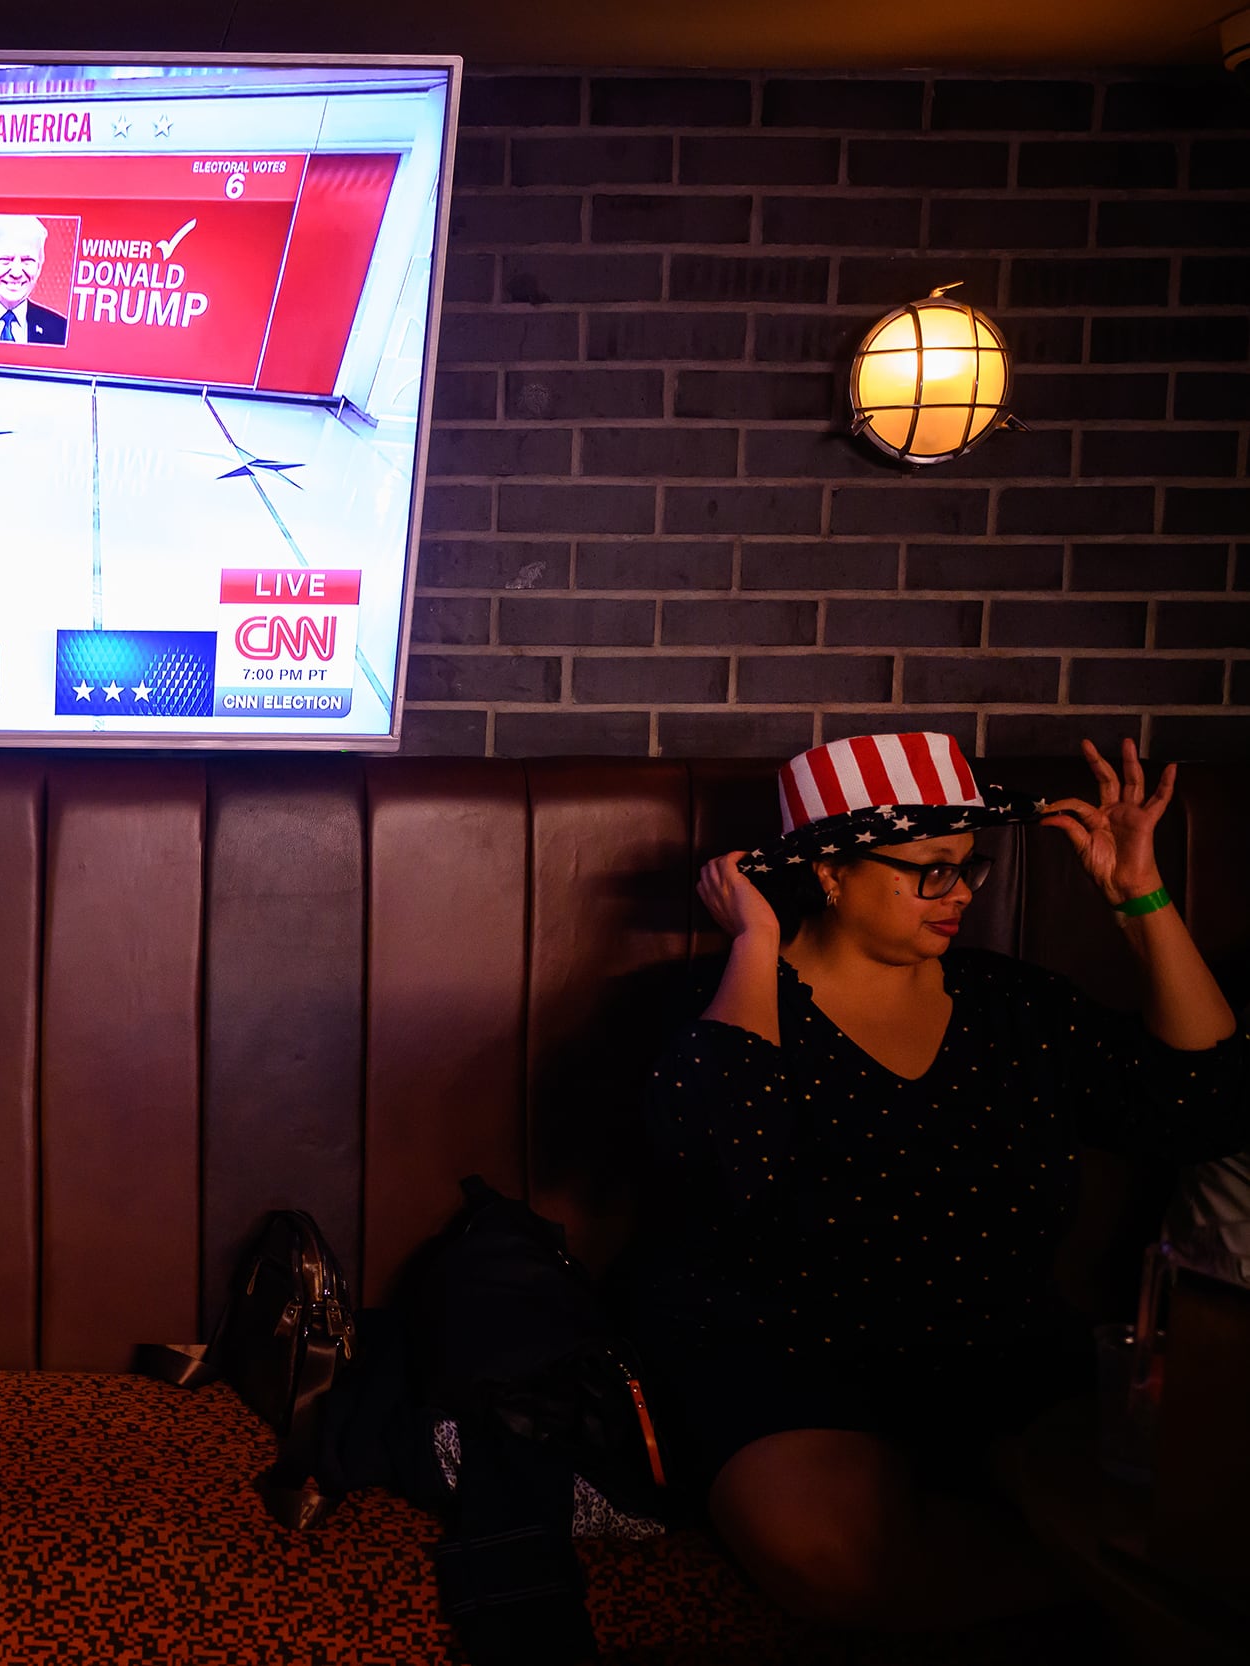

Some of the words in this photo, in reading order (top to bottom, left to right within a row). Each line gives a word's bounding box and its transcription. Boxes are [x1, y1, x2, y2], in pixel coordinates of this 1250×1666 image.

[192, 161, 250, 173] ELECTORAL
[252, 161, 287, 173] VOTES
[224, 172, 246, 199] 6
[81, 239, 153, 259] WINNER
[77, 260, 186, 290] DONALD
[73, 286, 209, 328] TRUMP
[254, 572, 327, 597] LIVE
[234, 615, 338, 662] CNN
[242, 668, 274, 681] 7:00
[279, 668, 303, 681] PM
[308, 669, 328, 681] PT
[222, 693, 259, 710] CNN
[263, 694, 343, 711] ELECTION
